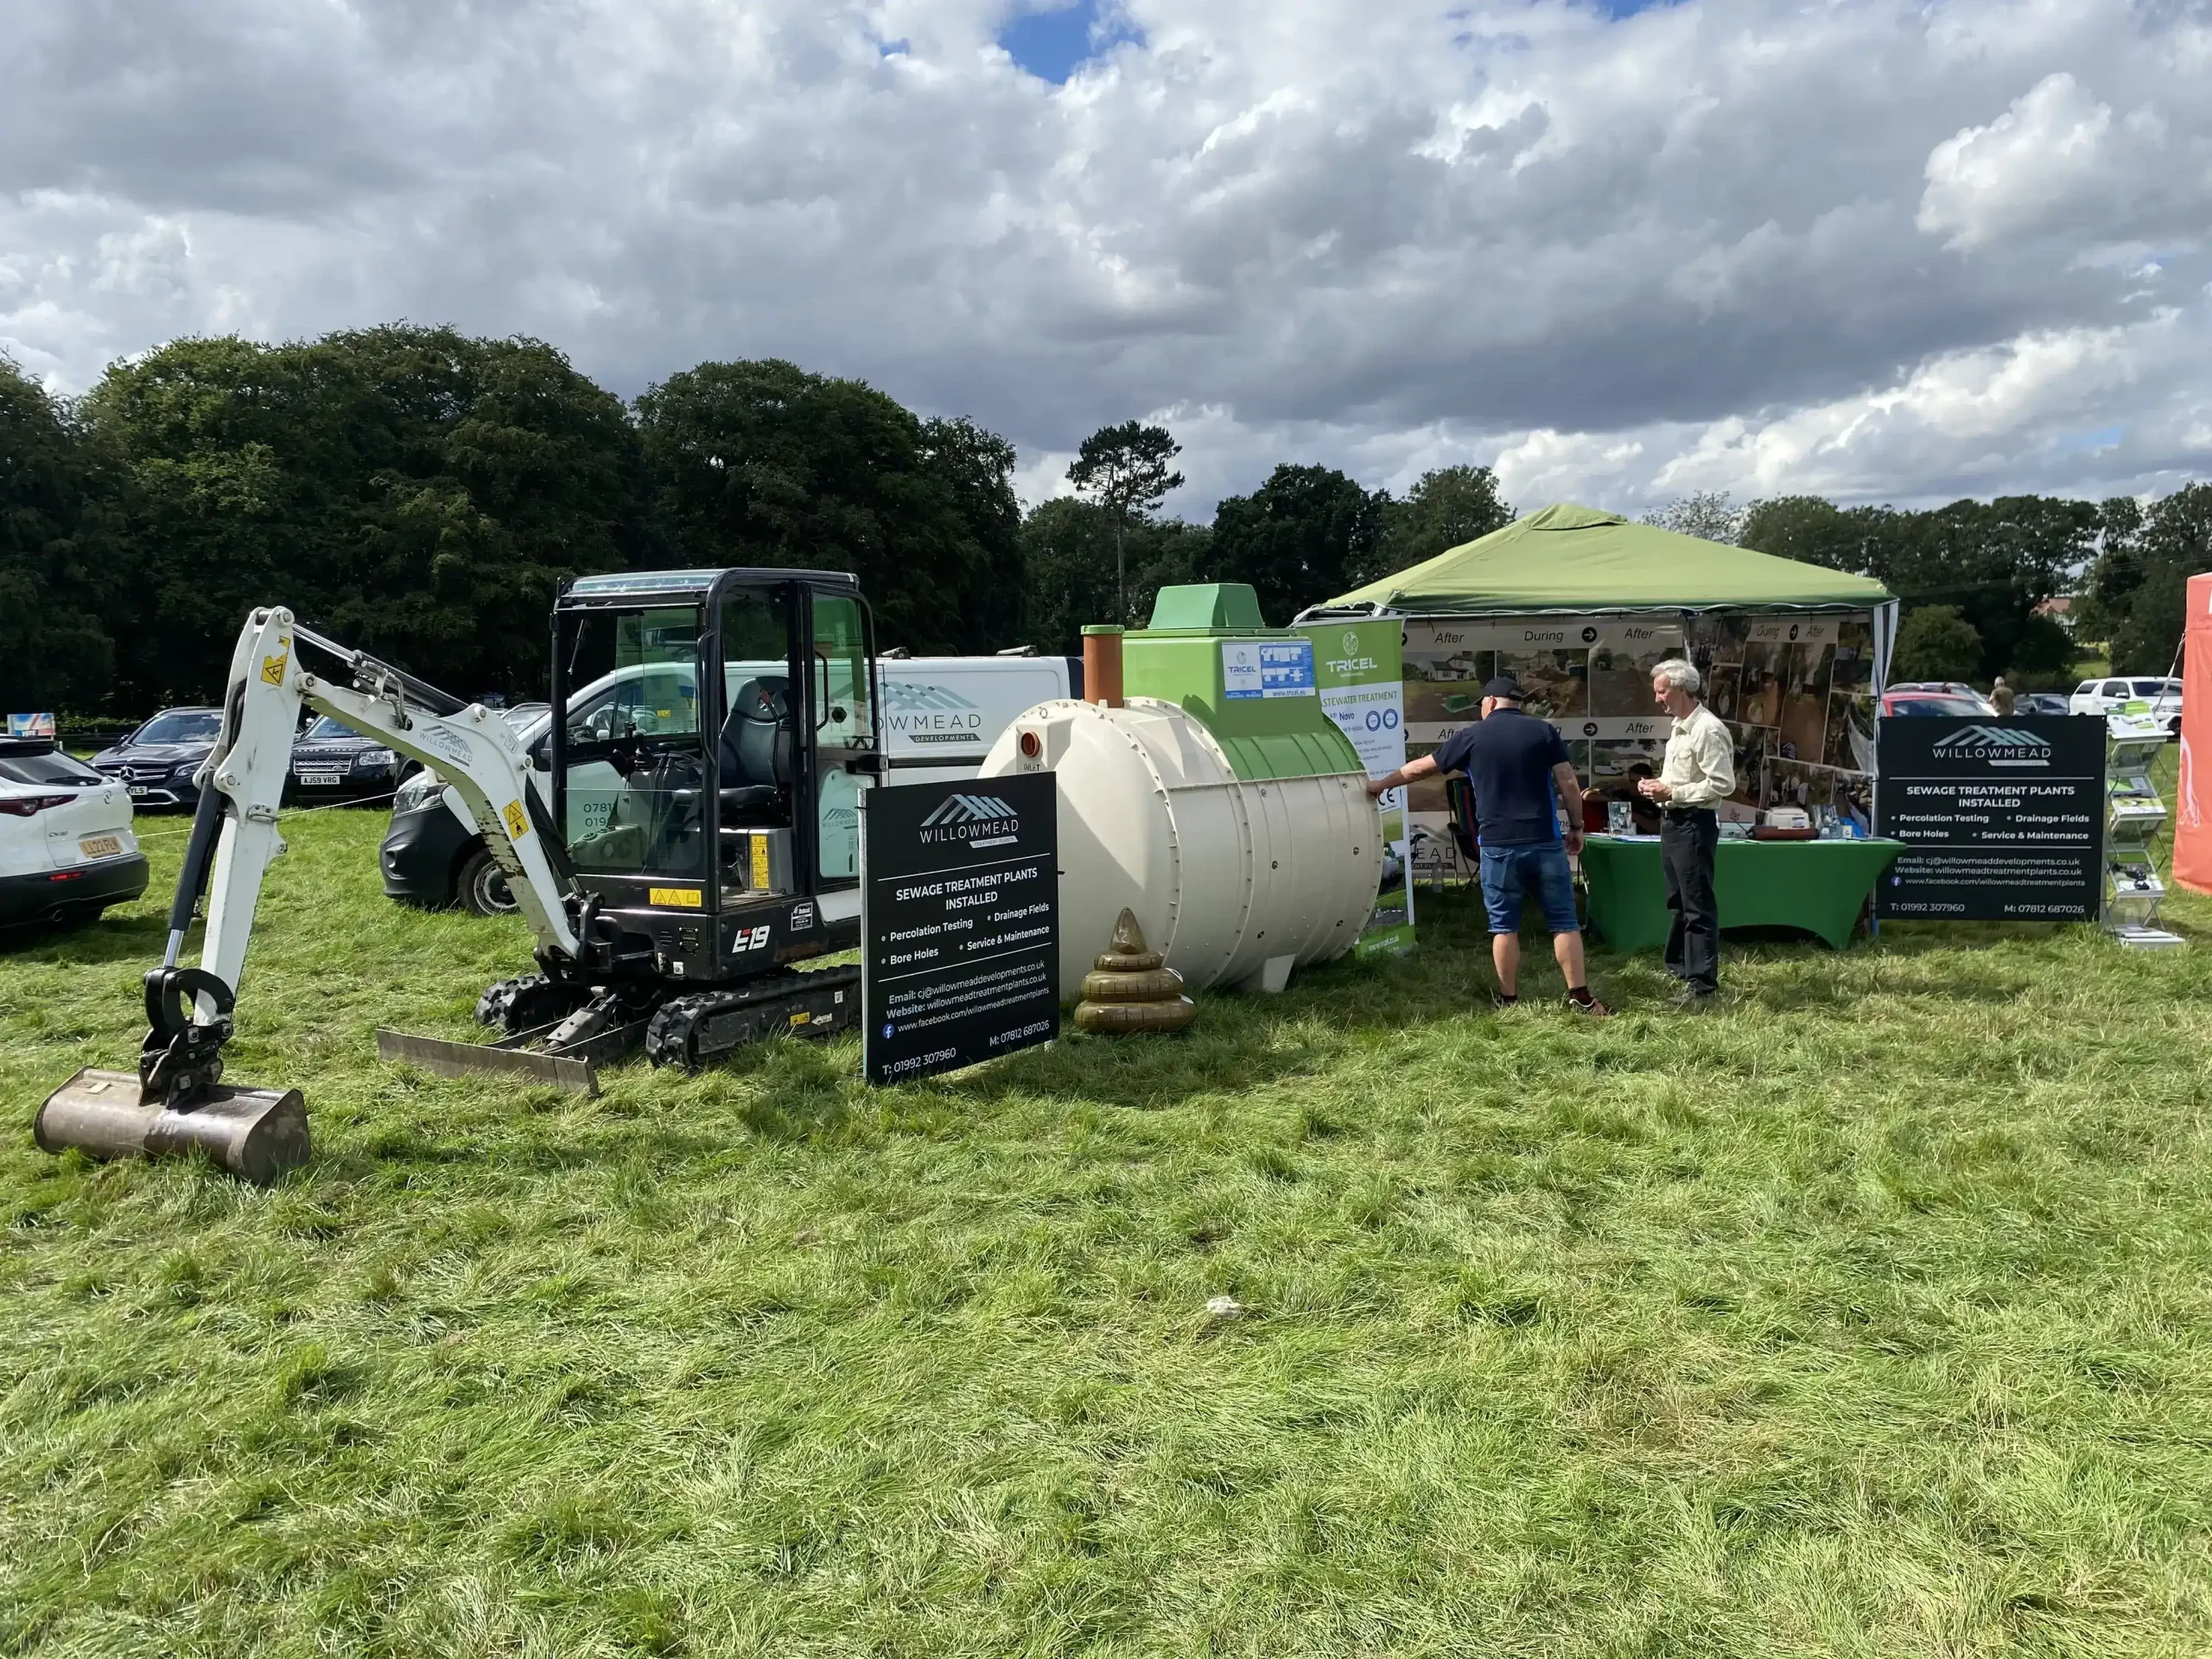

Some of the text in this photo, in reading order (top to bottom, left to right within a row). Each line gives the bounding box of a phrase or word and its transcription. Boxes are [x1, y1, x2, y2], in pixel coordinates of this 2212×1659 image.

[1434, 631, 1465, 645] After
[1523, 630, 1564, 643] During
[1624, 628, 1655, 640] After
[1325, 657, 1378, 673] TRICEL
[1322, 690, 1398, 708] STEWATER TREATMENT
[1339, 711, 1355, 721] Novo
[1625, 722, 1654, 734] After
[915, 734, 975, 743] DEVELOPMENTS
[419, 732, 473, 762] WILLOWMEAD
[1932, 747, 2051, 759] WILLOWMEAD
[1023, 764, 1040, 772] INLET
[1906, 785, 2075, 797] SEWAGE TREATMENT PLANTS
[583, 803, 613, 813] 0781
[1958, 798, 2021, 809] INSTALLED
[1899, 813, 1990, 824] Percolation Testing
[2015, 814, 2090, 824] Drainage Fields
[919, 819, 1019, 844] WILLOWMEAD
[1899, 829, 1949, 839] Bore Holes
[1981, 830, 2089, 841] Service & Maintenance
[1897, 856, 2080, 867] Email: cj@willowmeaddevelopments.co.uk
[1895, 866, 2082, 876] Website: willowmeadtreatmentplants.co.uk
[896, 867, 1038, 901] SEWAGE TREATMENT PLANTS
[1904, 877, 2086, 887] www.facebook.com/willowmeadtreatmentplants
[945, 891, 998, 910] INSTALLED
[994, 902, 1049, 922] Drainage Fields
[1890, 903, 1965, 912] T: 01992 307960
[2004, 904, 2085, 914] M: 07812 687026
[890, 918, 973, 942] Percolation Testing
[732, 925, 771, 954] E19
[967, 925, 1050, 950] Service & Maintenance
[890, 947, 939, 965] Bore Holes
[888, 959, 1045, 1005] Email: cj@willowmeaddevelopments.co.uk
[887, 971, 1047, 1020] Website: willowmeadtreatmentplants.co.uk
[897, 986, 1050, 1033] www.facebook.com/willowmeadtreatmentplants
[989, 1020, 1050, 1046] M: 07812 687026
[882, 1046, 957, 1075] T: 01992 307960
